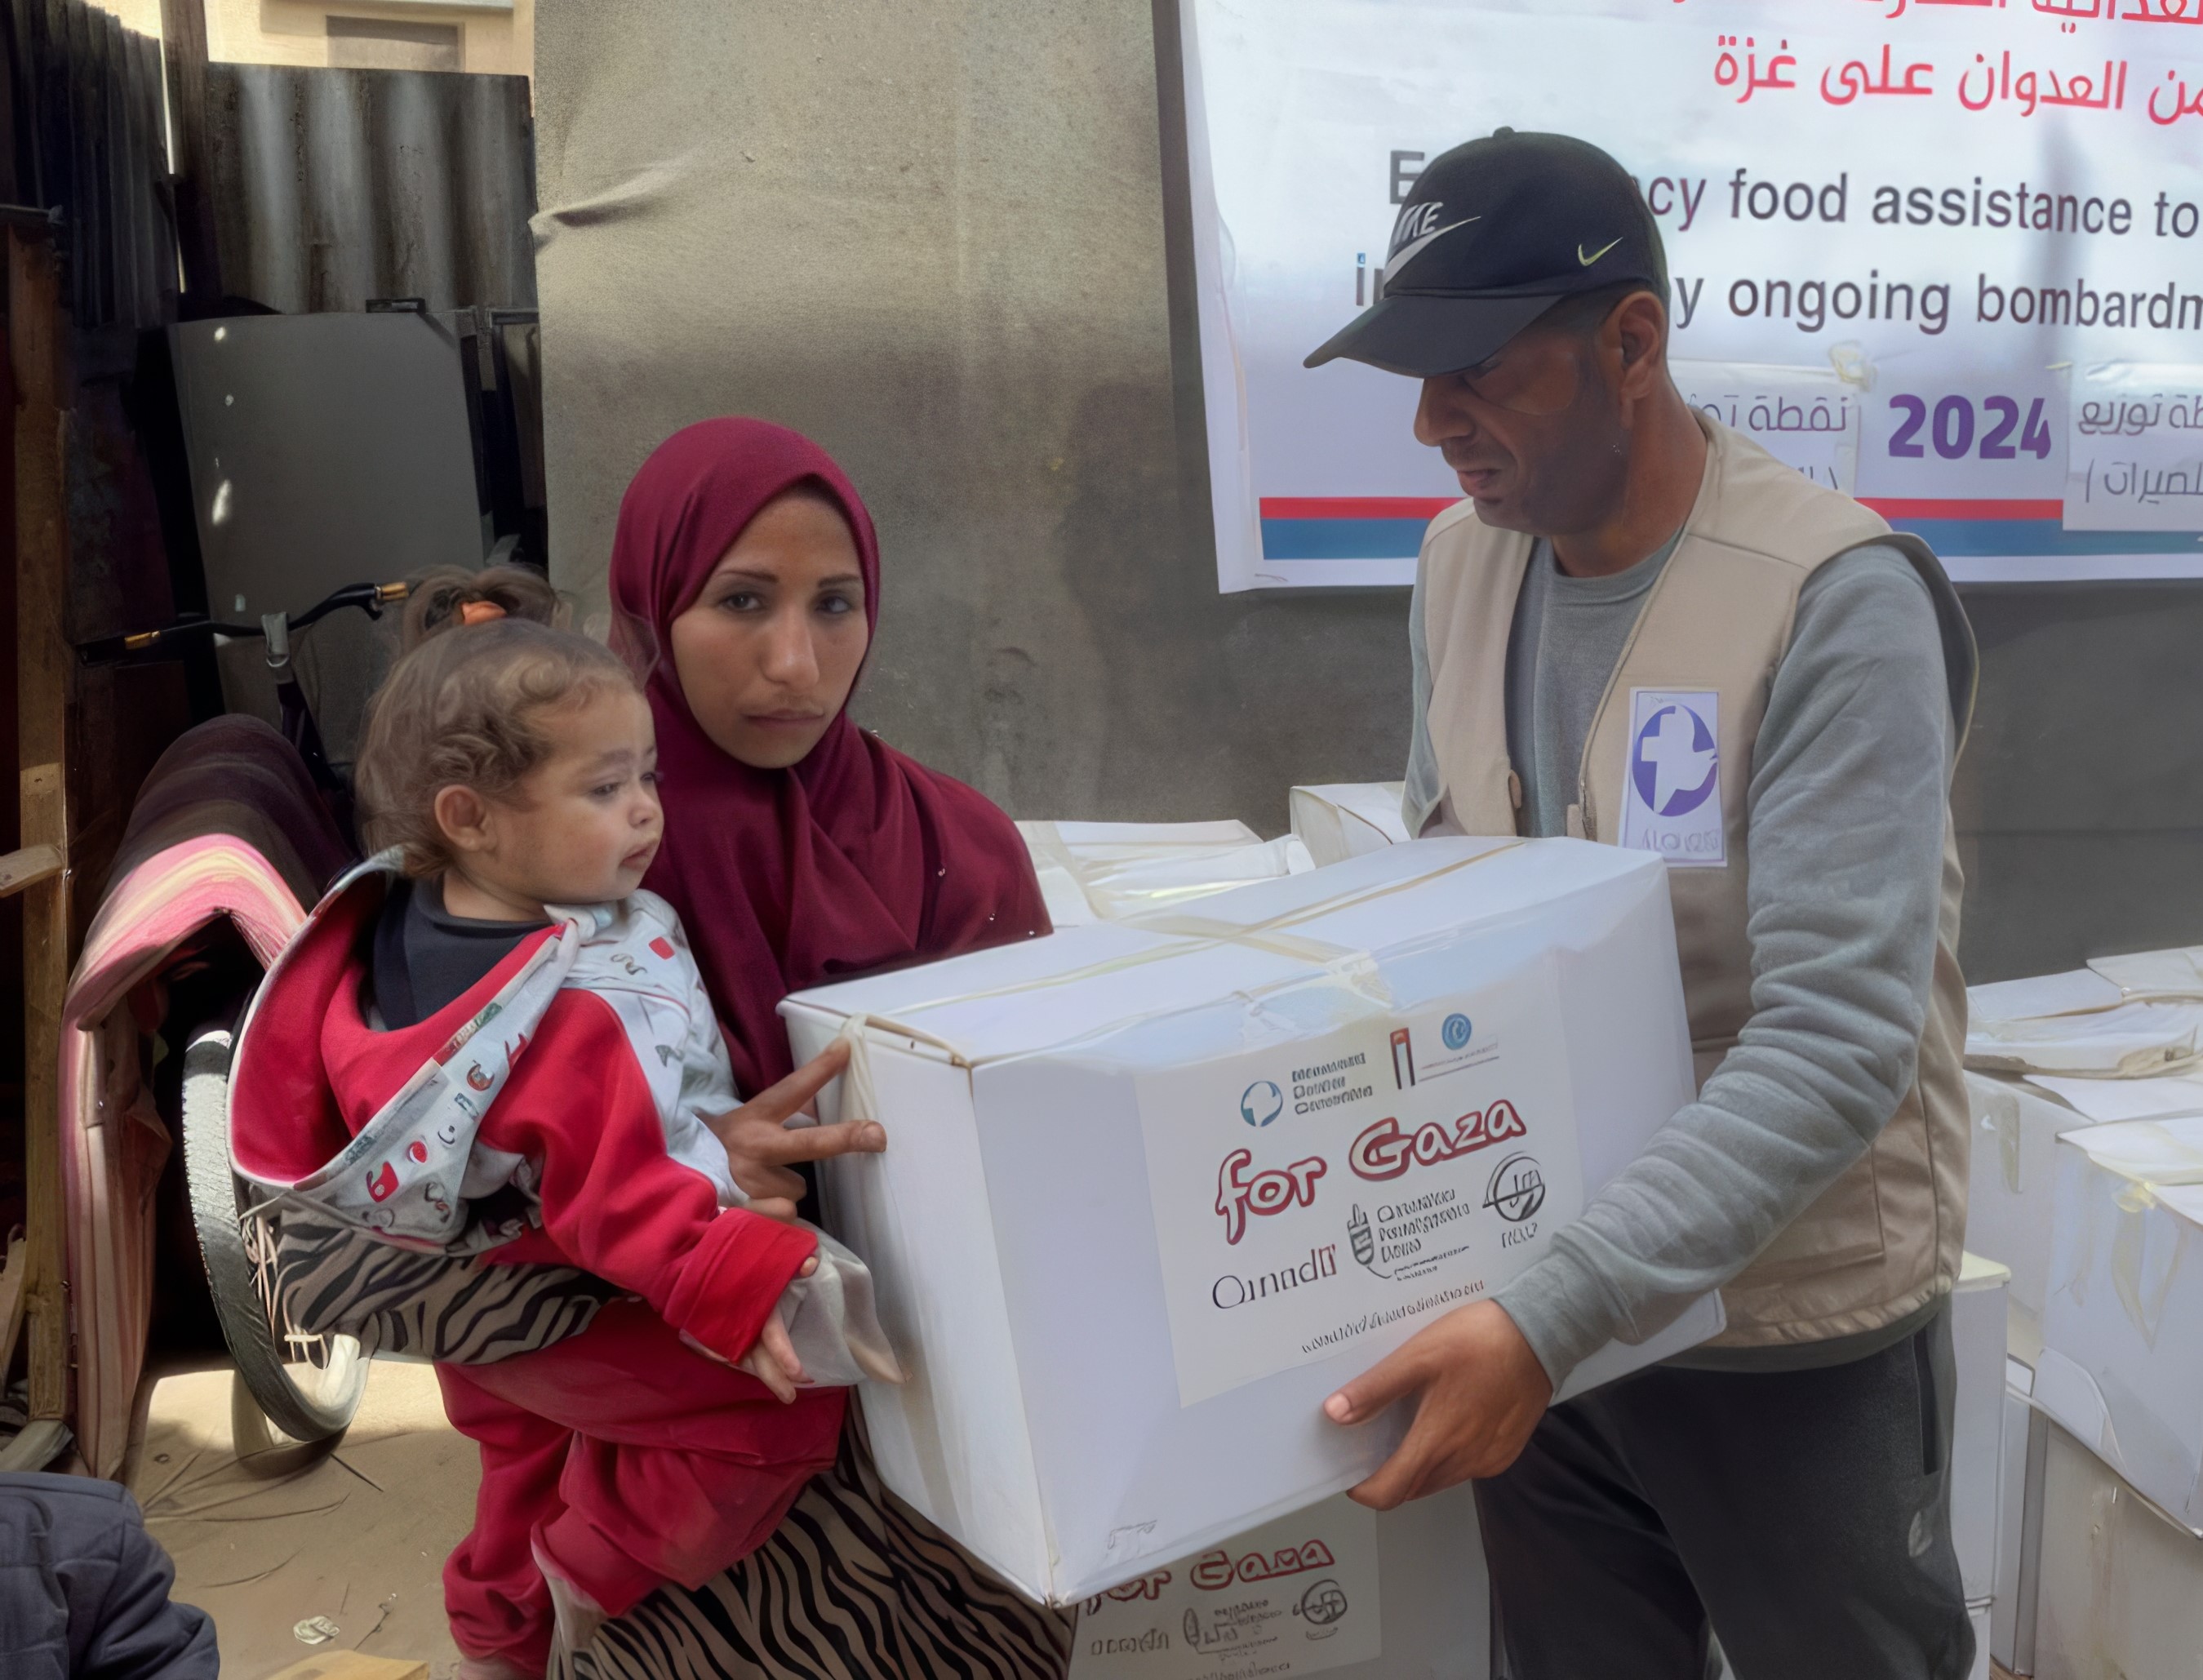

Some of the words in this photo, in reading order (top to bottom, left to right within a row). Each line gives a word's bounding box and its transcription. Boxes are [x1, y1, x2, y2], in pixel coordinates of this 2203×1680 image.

[1714, 34, 1797, 104] غزة
[1819, 43, 1934, 106] على
[1958, 50, 2128, 118] العدوان
[1729, 167, 1848, 223] food
[1872, 176, 2132, 236] assistance
[2154, 191, 2200, 238] to
[1728, 269, 1951, 336] ongoing
[1887, 393, 2052, 460] 2024
[1215, 1148, 1328, 1246] for
[1349, 1099, 1527, 1181] Gaza
